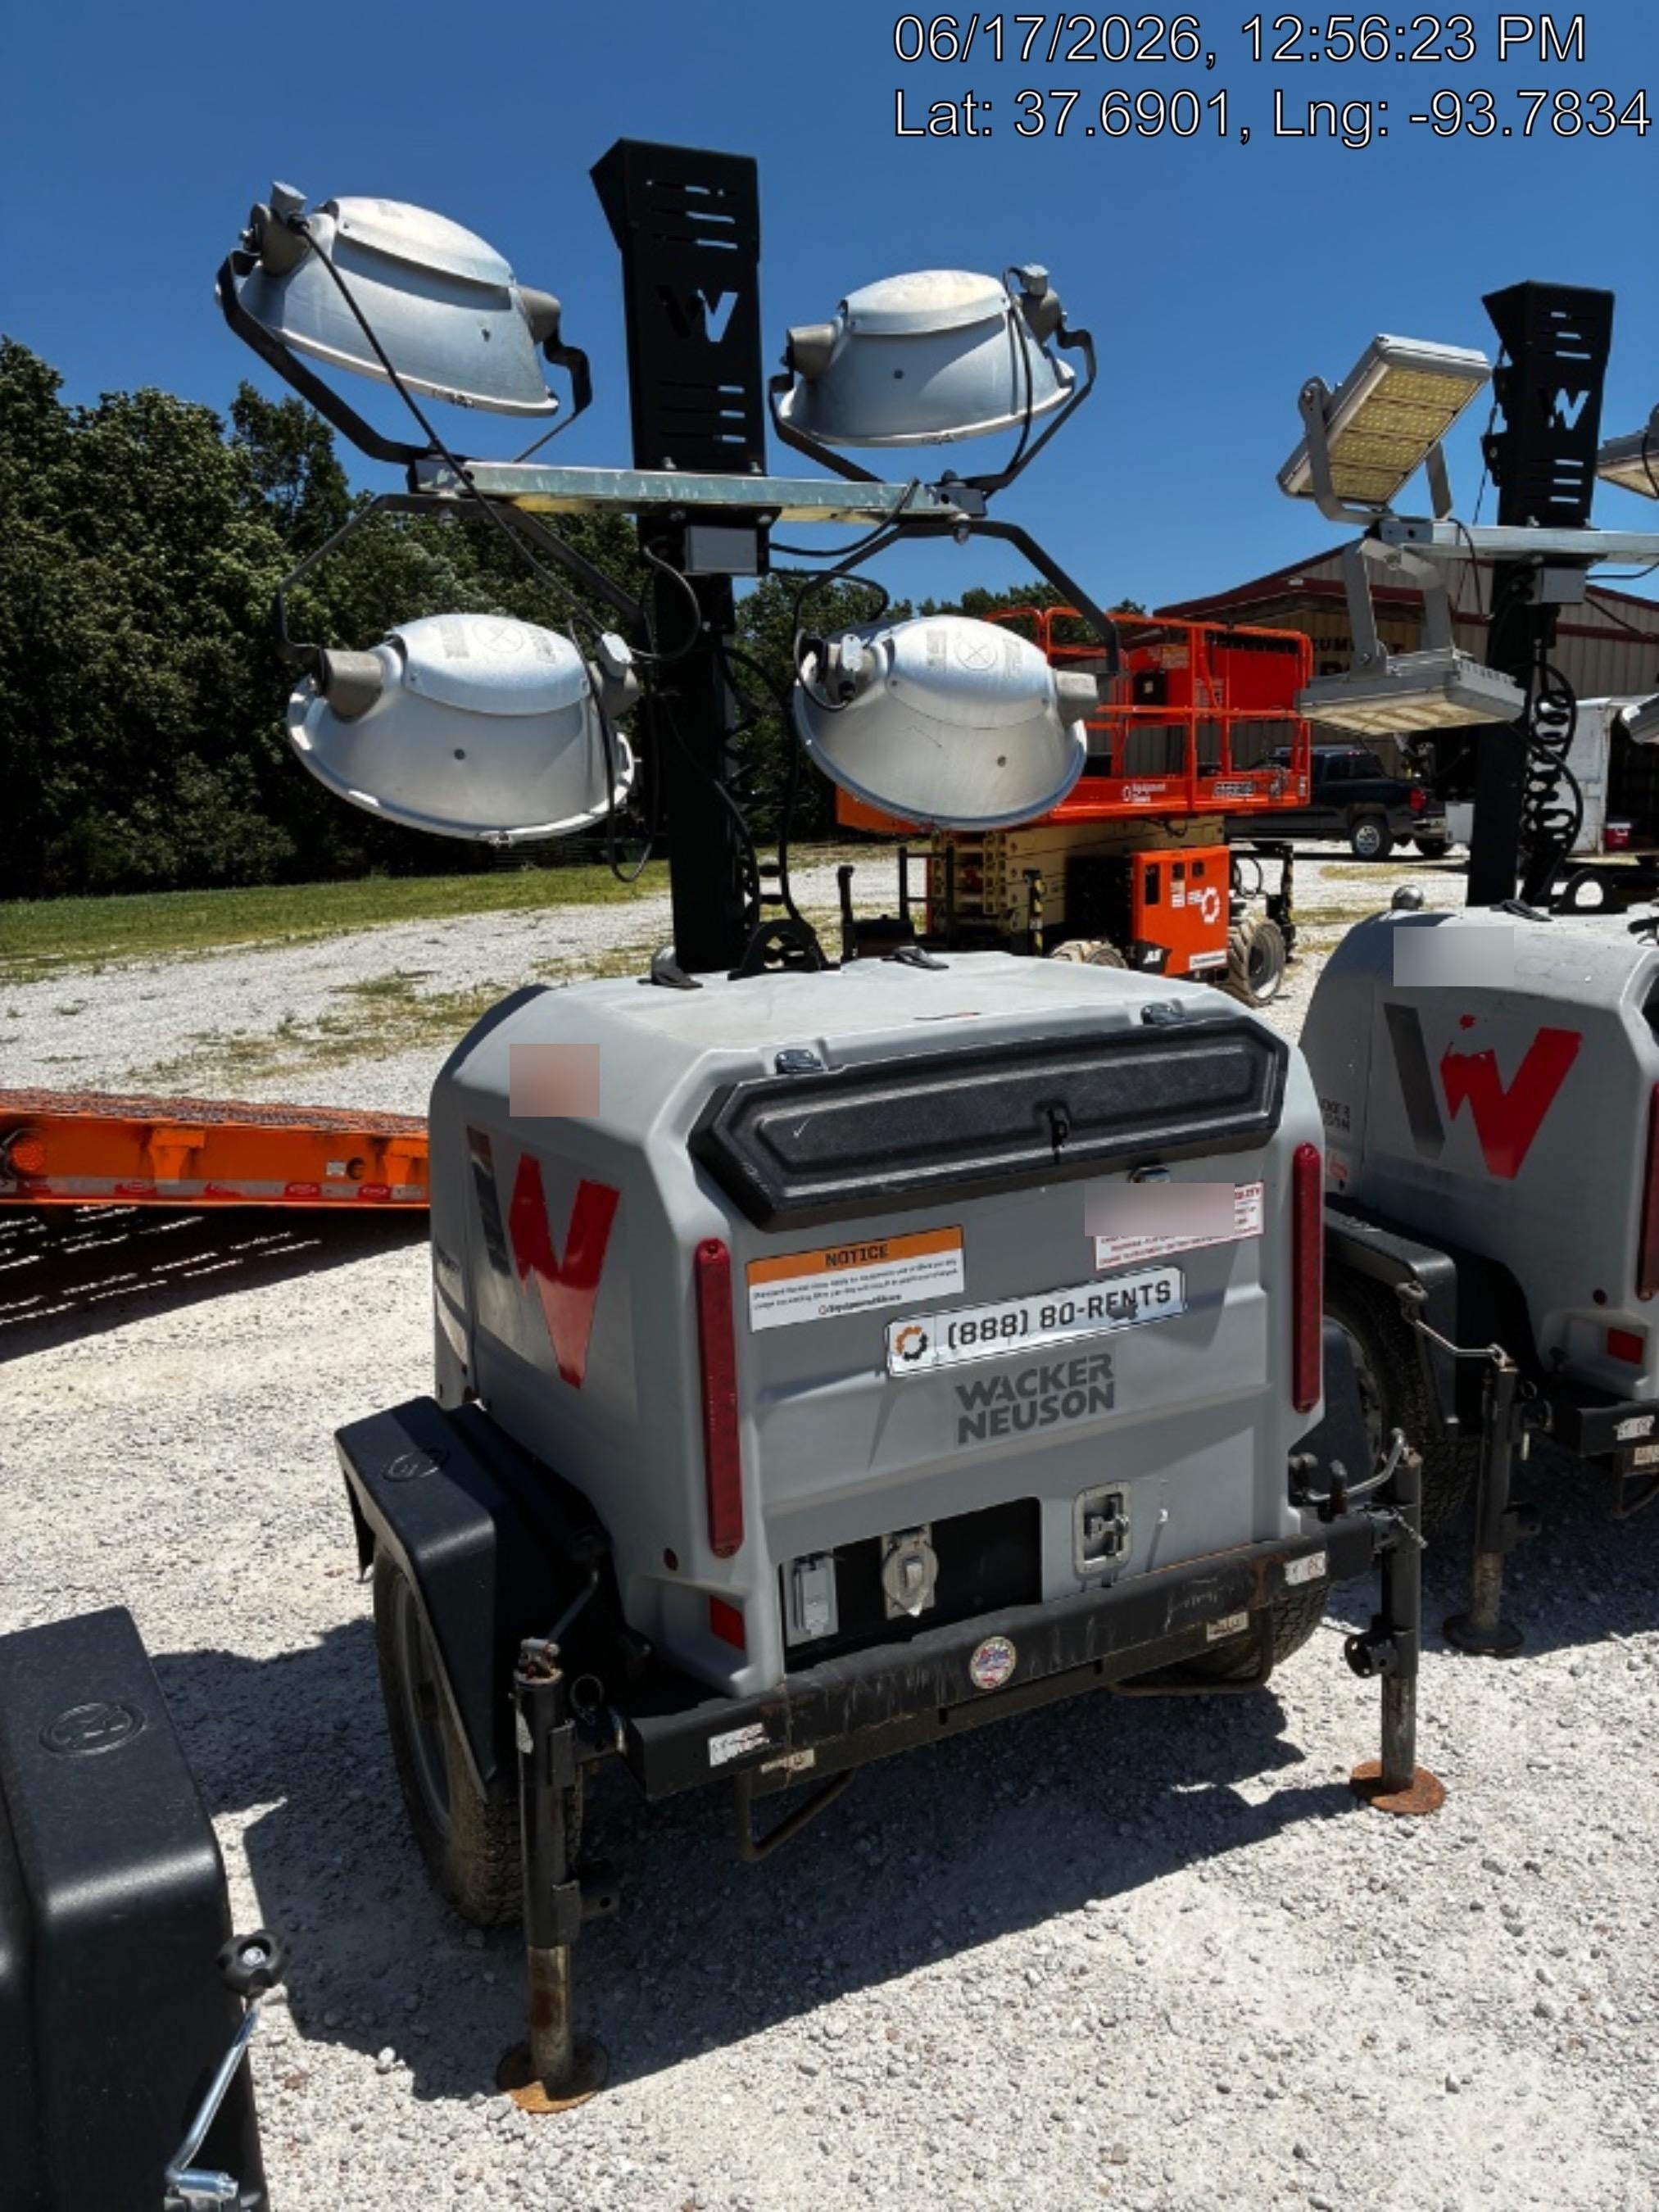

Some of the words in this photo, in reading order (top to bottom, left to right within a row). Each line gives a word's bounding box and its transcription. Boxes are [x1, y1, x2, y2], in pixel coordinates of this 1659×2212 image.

[825, 1244, 889, 1267] NOTICE
[947, 1309, 1029, 1350] (888)
[1038, 1280, 1172, 1330] 80-RENTS
[954, 1353, 1115, 1412] WACKER
[957, 1382, 1115, 1445] NEUSON
